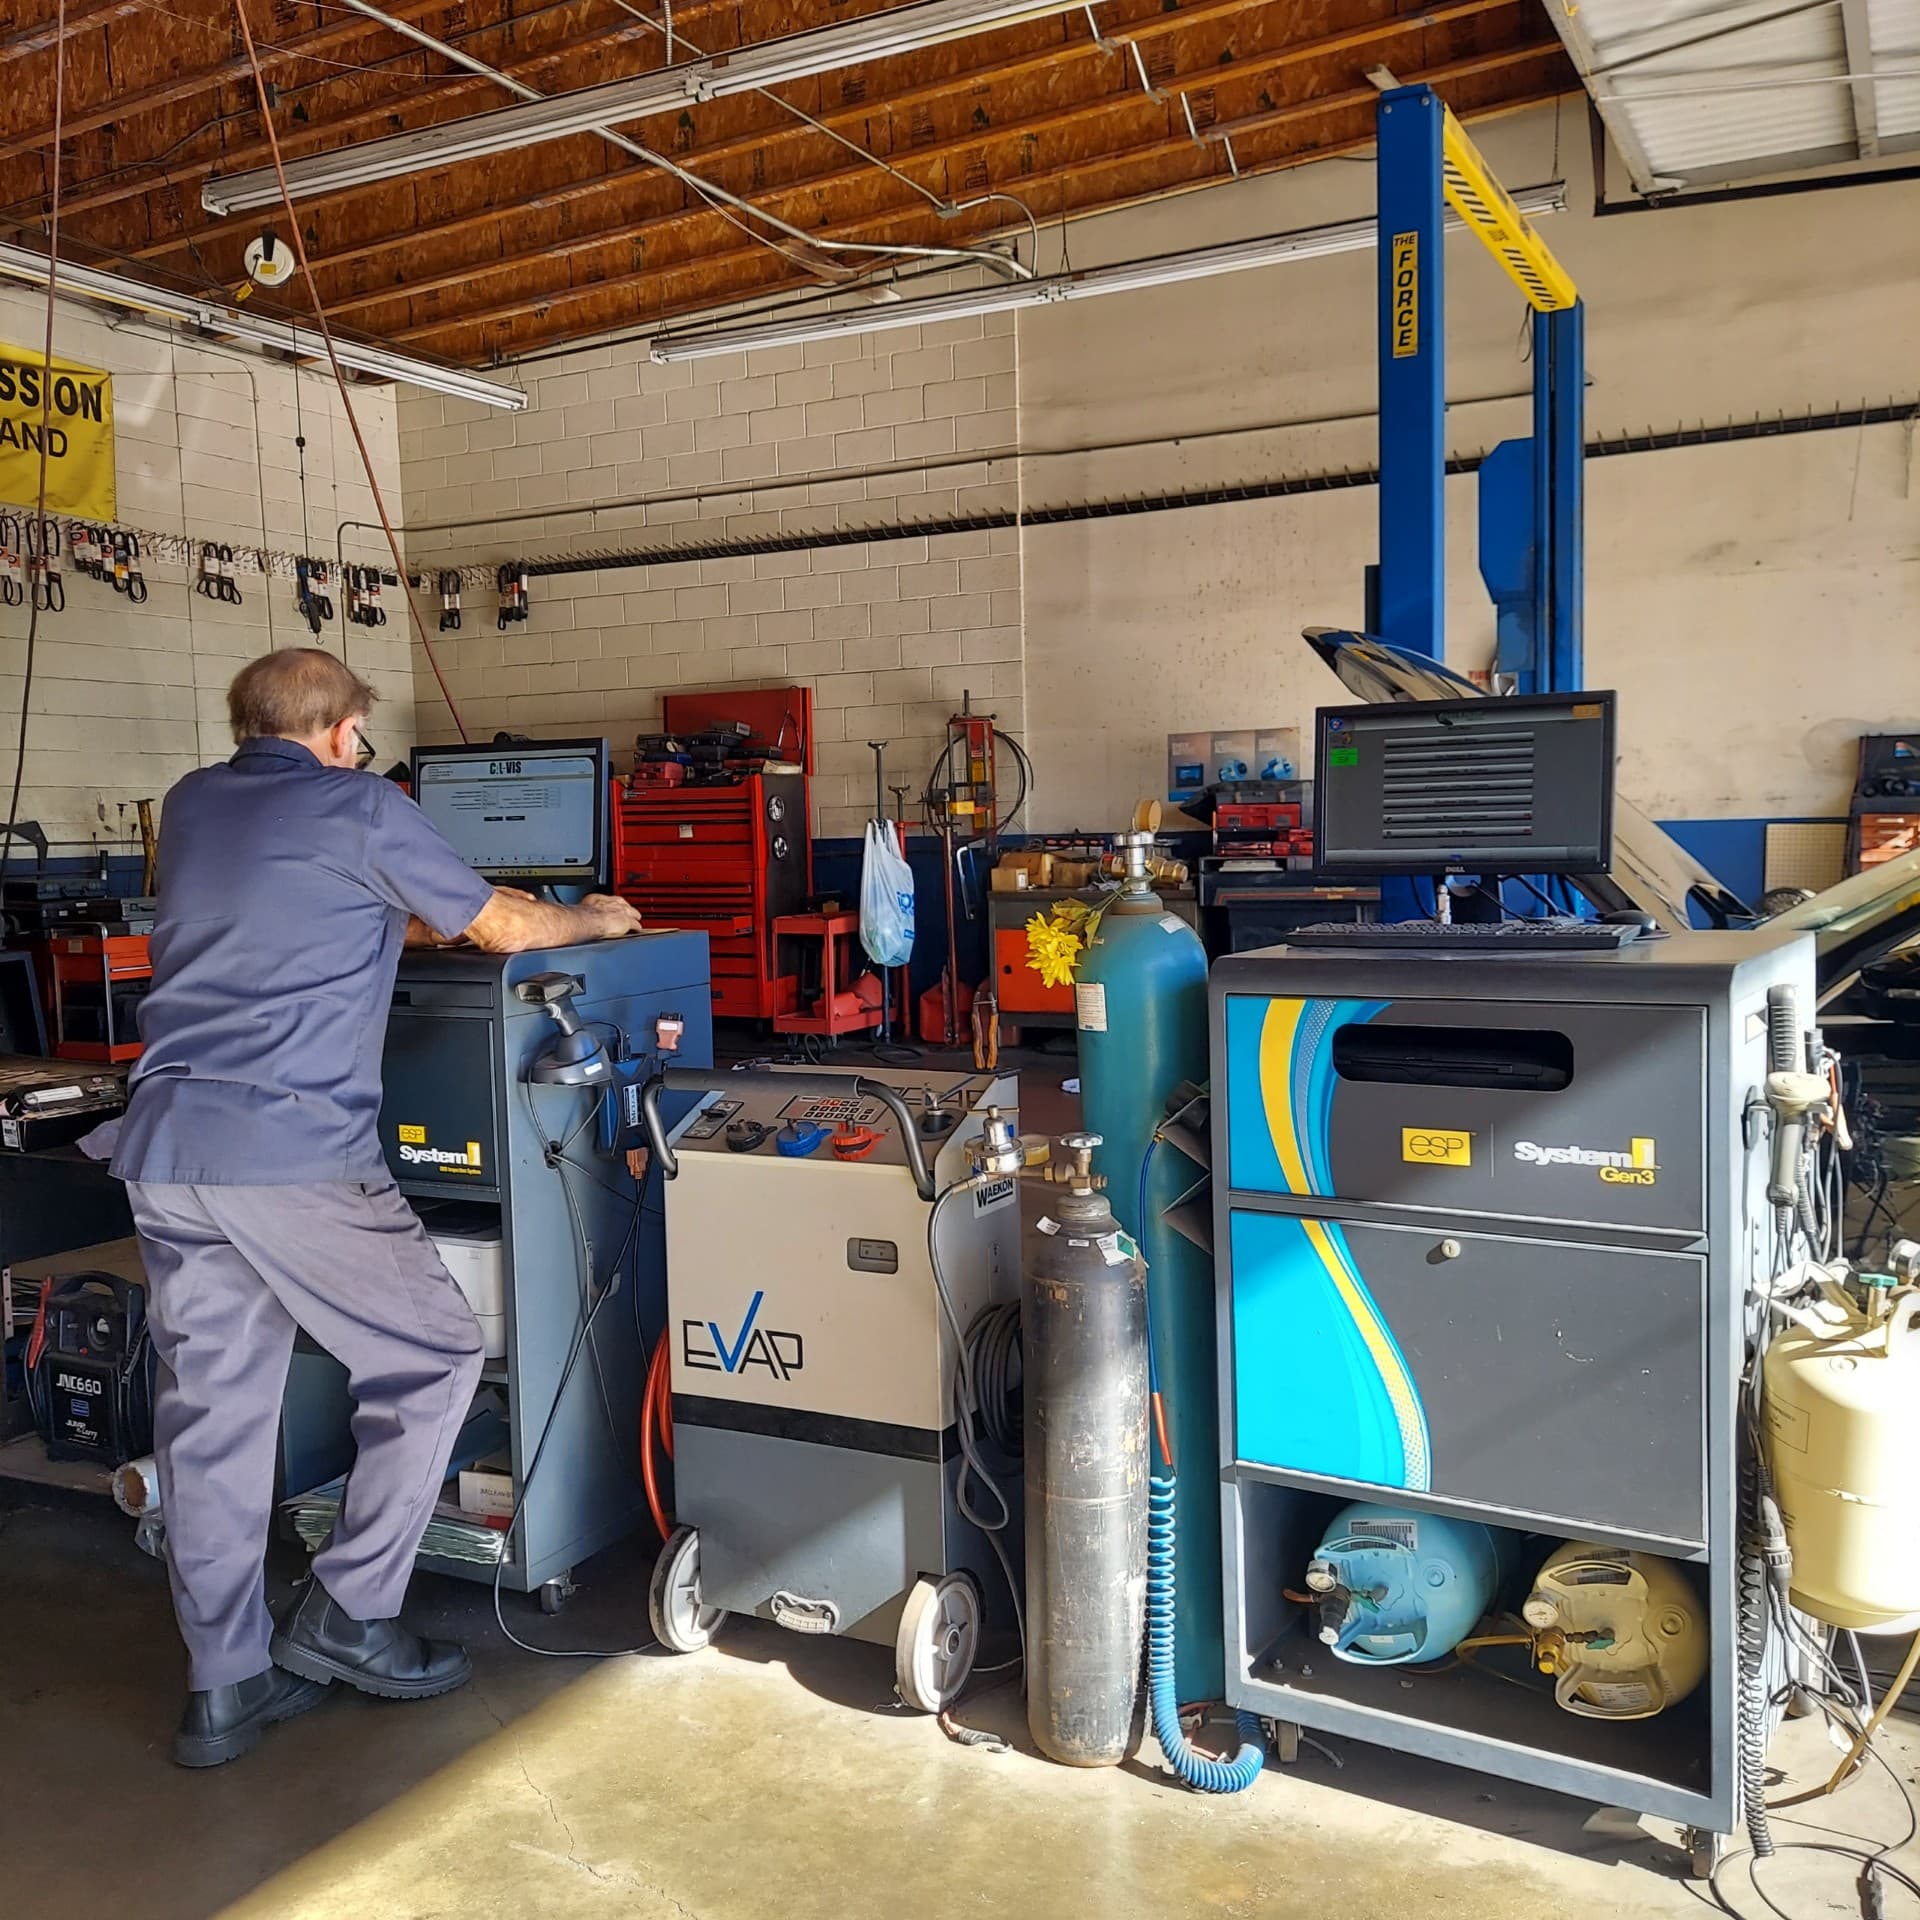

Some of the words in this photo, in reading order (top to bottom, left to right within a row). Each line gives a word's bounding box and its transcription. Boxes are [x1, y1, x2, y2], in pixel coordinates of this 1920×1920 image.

[1394, 234, 1416, 247] THE
[1397, 249, 1414, 348] FORCE
[1600, 1168, 1655, 1184] Gen3
[683, 1291, 803, 1381] EVAP
[56, 1374, 102, 1395] JNC660
